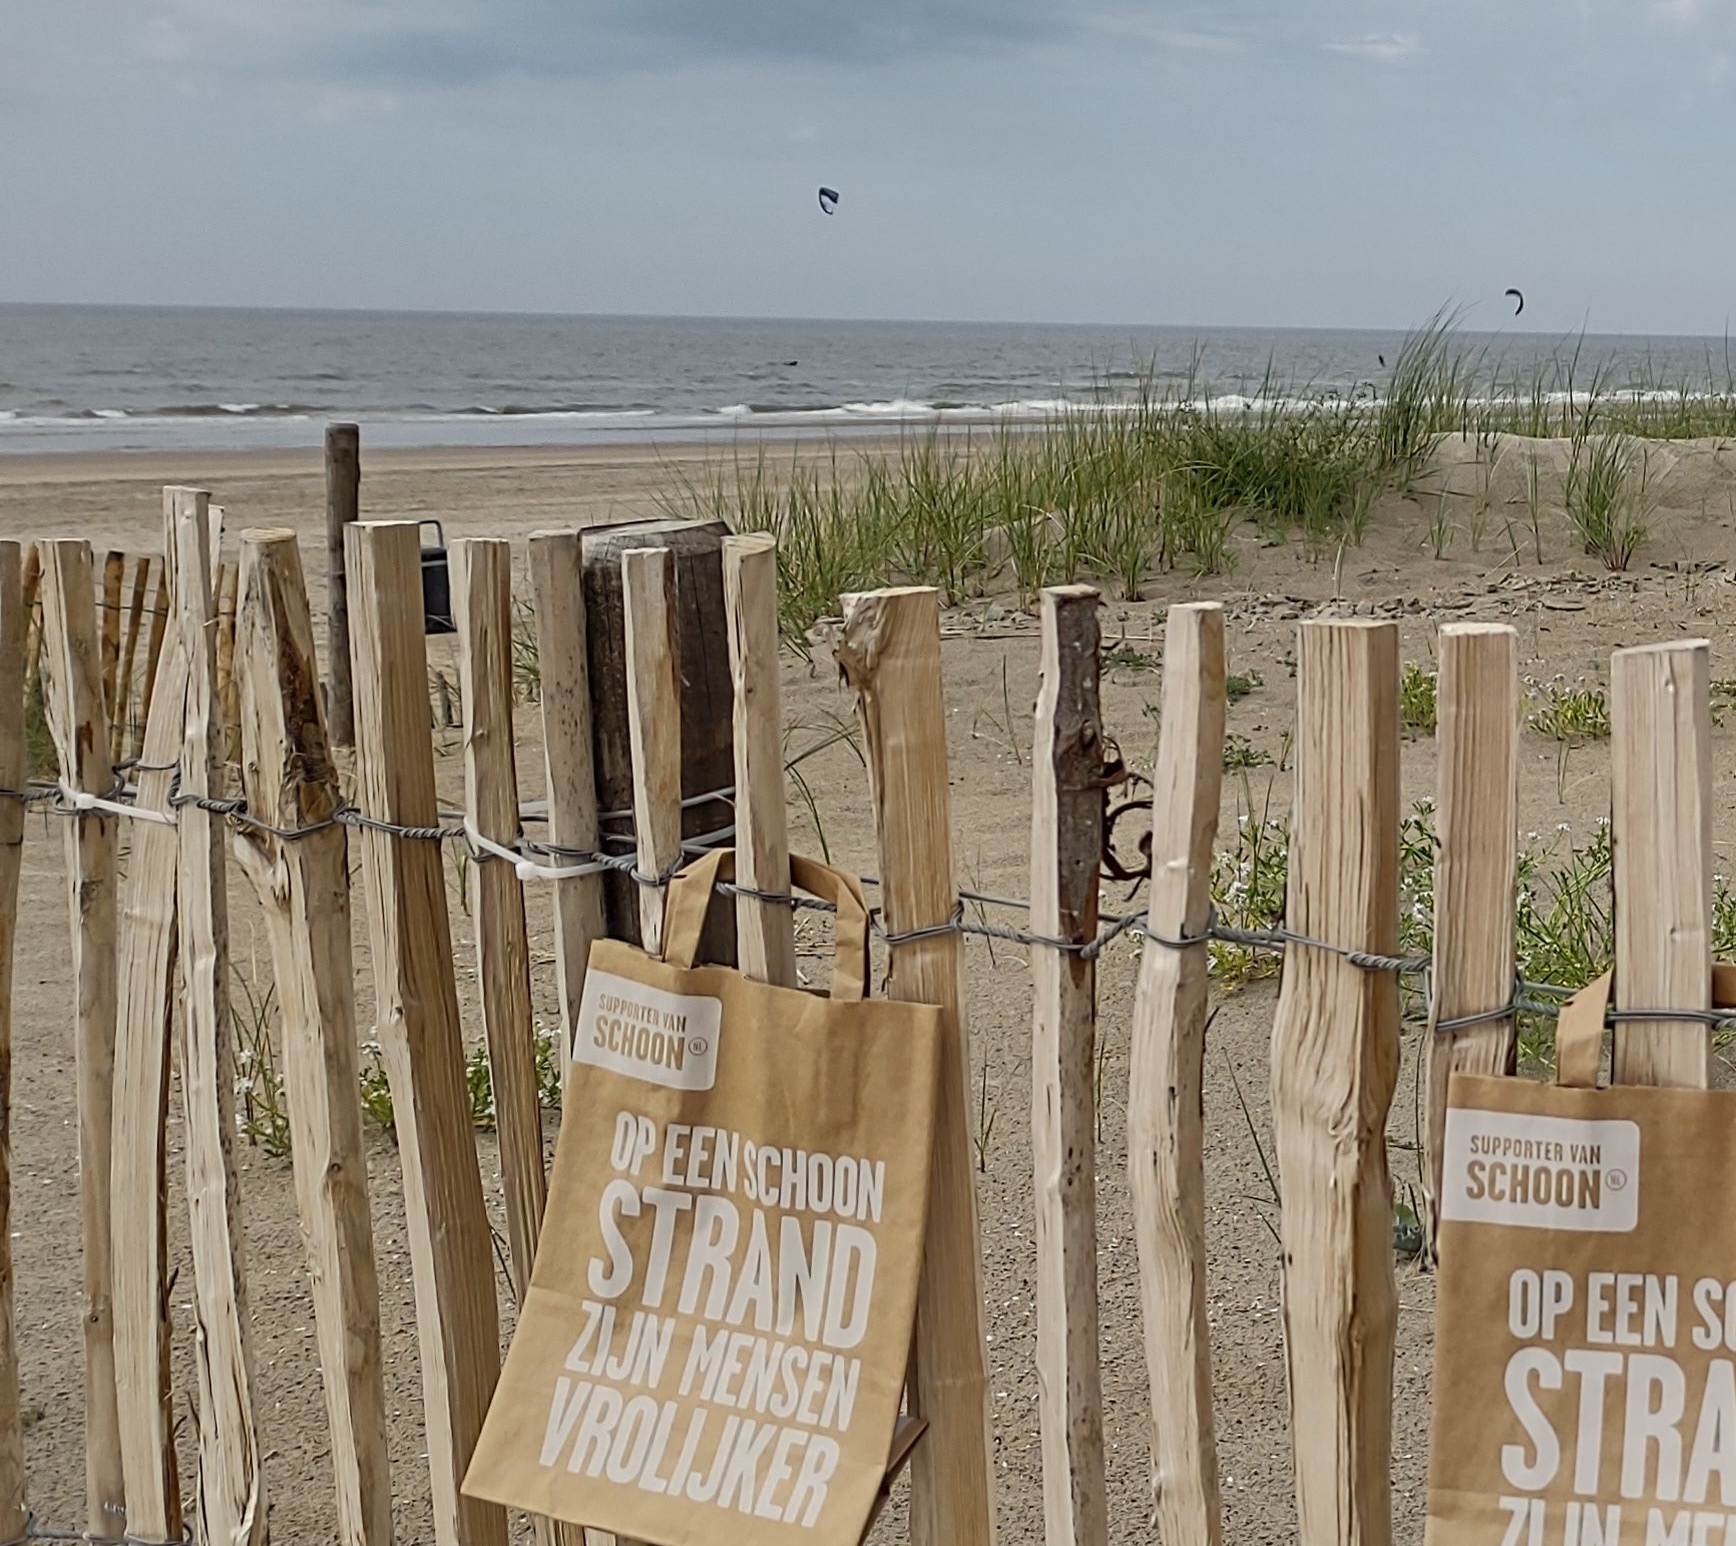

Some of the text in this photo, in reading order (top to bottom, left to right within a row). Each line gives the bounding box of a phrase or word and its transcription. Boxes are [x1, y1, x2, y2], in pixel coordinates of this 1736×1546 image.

[594, 1015, 685, 1071] SCHOON
[599, 994, 686, 1032] SUPPORTER VAN
[611, 1111, 885, 1223] OP EEN SCHOON
[1466, 1160, 1601, 1209] SCHOON
[1470, 1135, 1600, 1164] SUPPORTER VAN
[588, 1179, 877, 1349] STRAND
[1508, 1269, 1573, 1341] OP
[1587, 1273, 1678, 1348] EEN
[565, 1300, 861, 1433] ZIJN MENSEN
[538, 1376, 840, 1529] VROLIJKER
